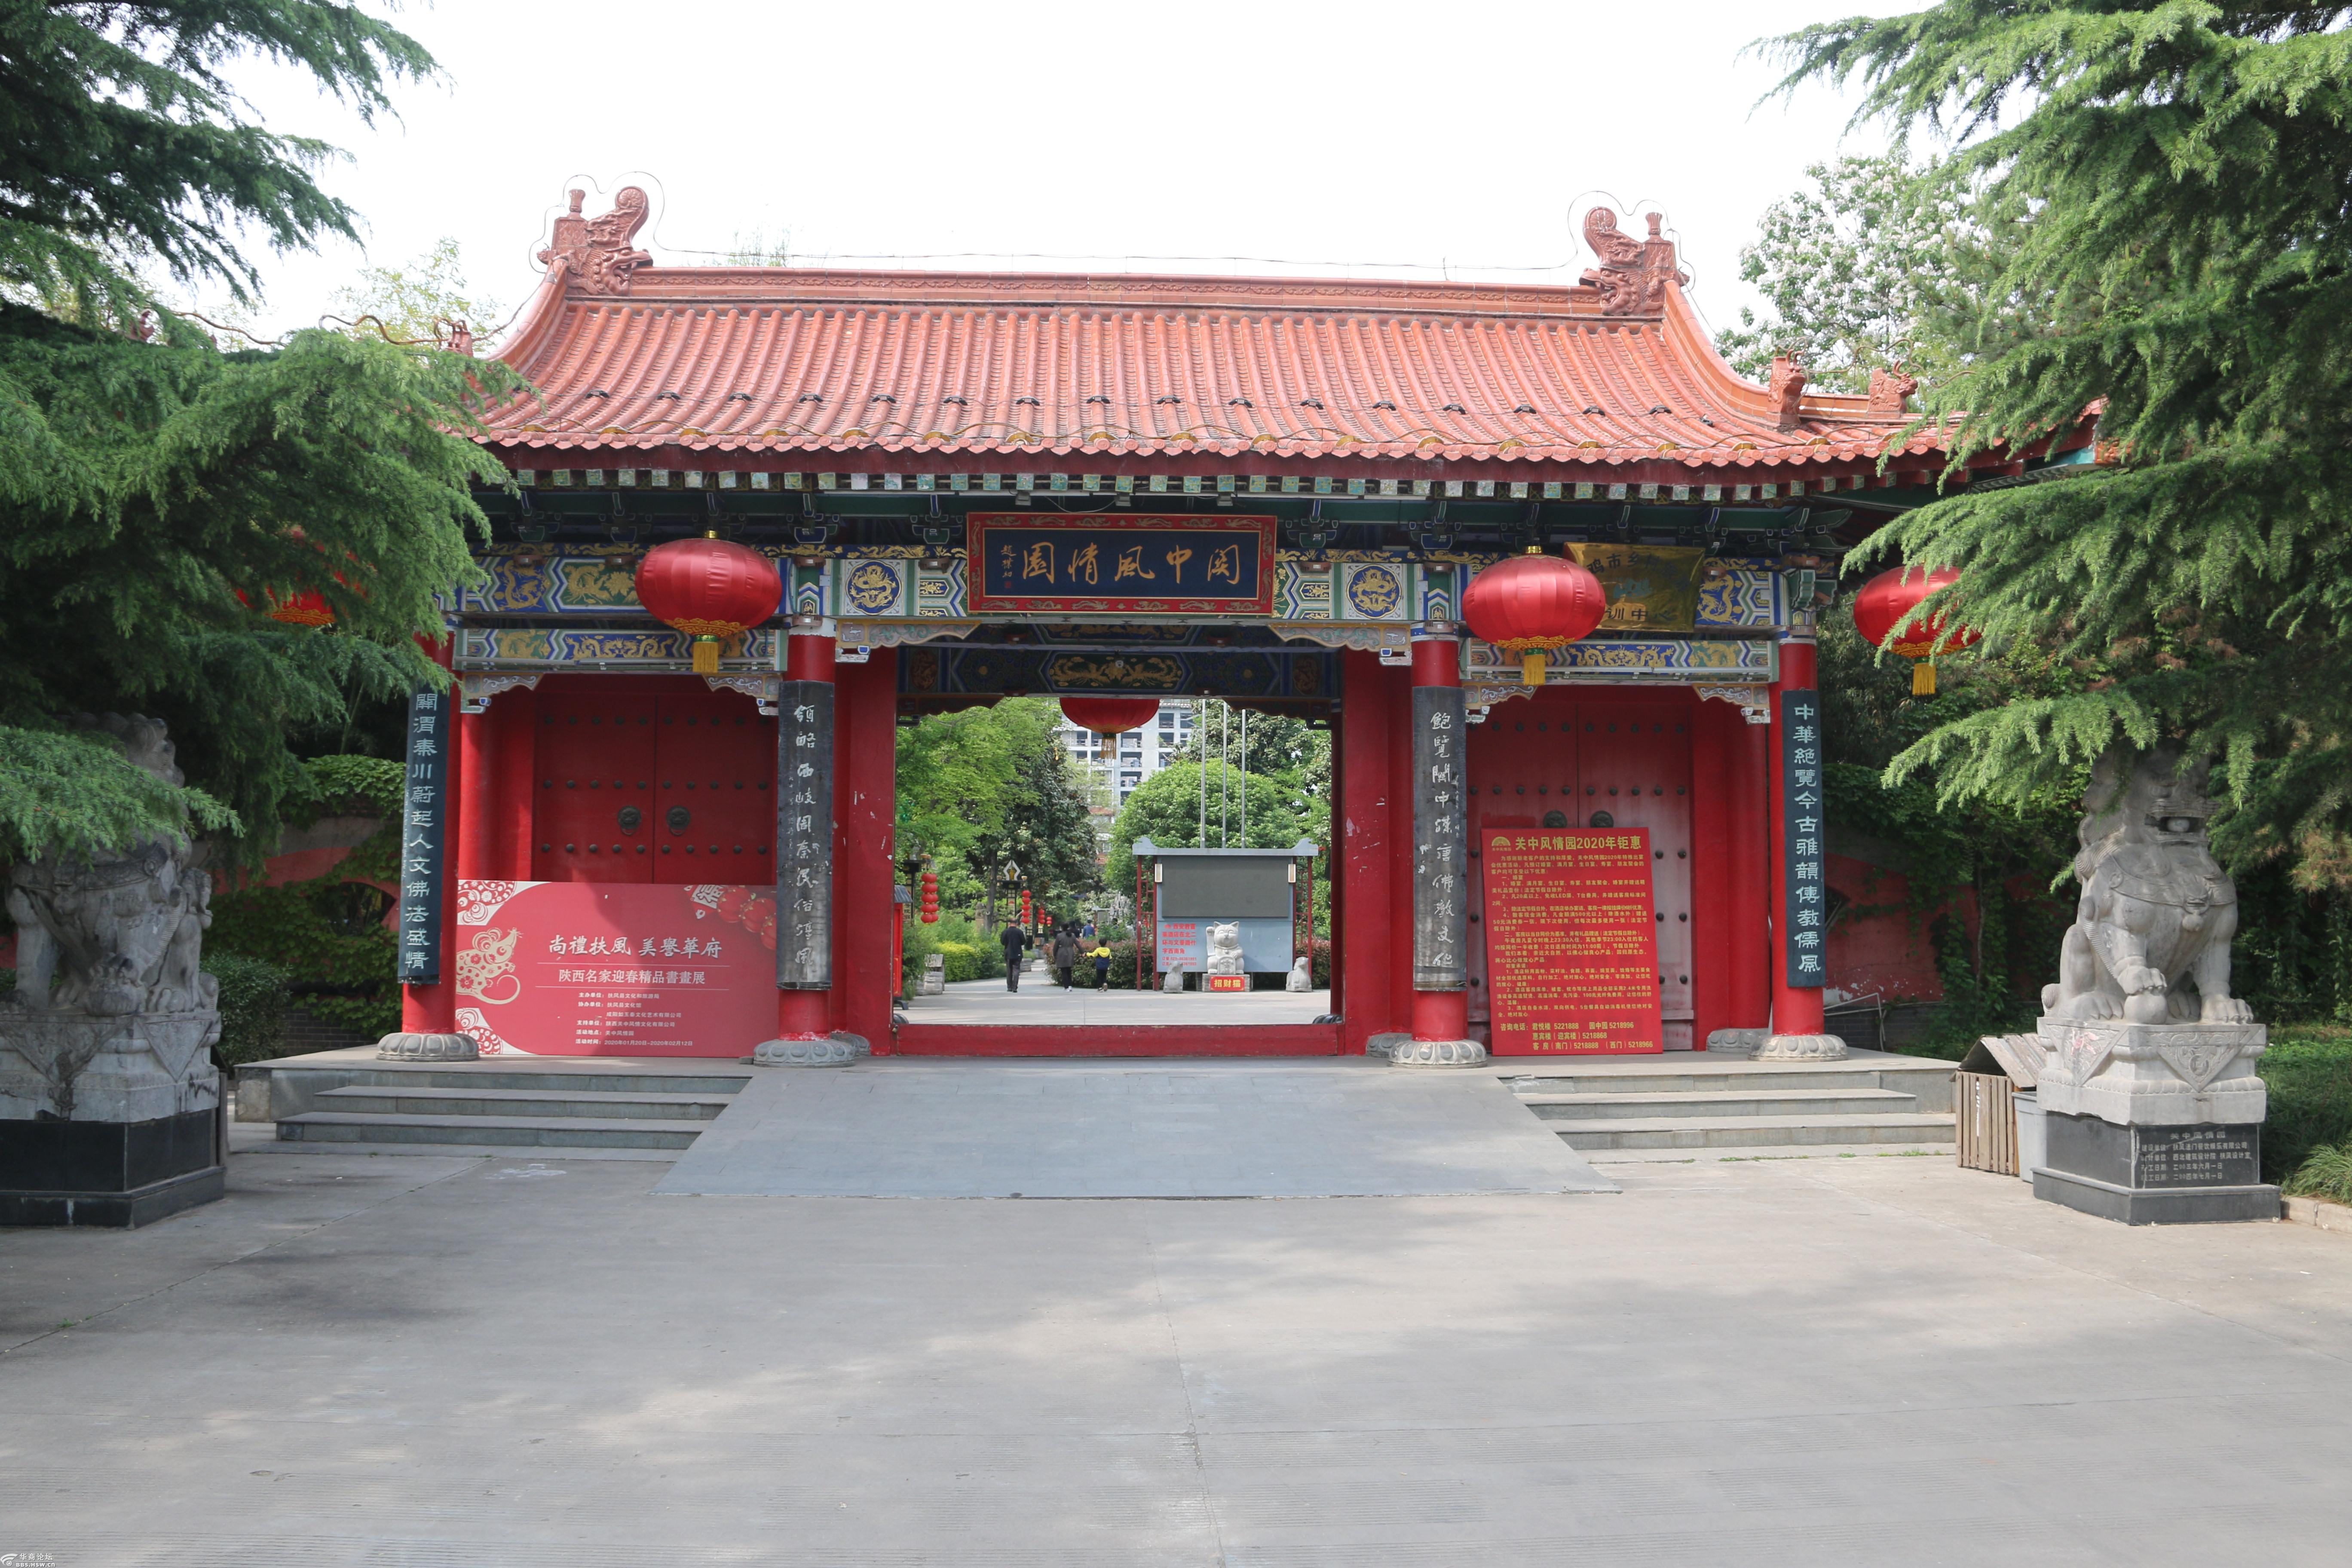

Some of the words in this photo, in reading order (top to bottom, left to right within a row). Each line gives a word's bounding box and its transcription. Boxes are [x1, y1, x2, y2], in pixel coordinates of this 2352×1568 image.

[1515, 836, 1641, 851] 关中风情园2020年钜惠
[1214, 979, 1241, 988] 招财猫
